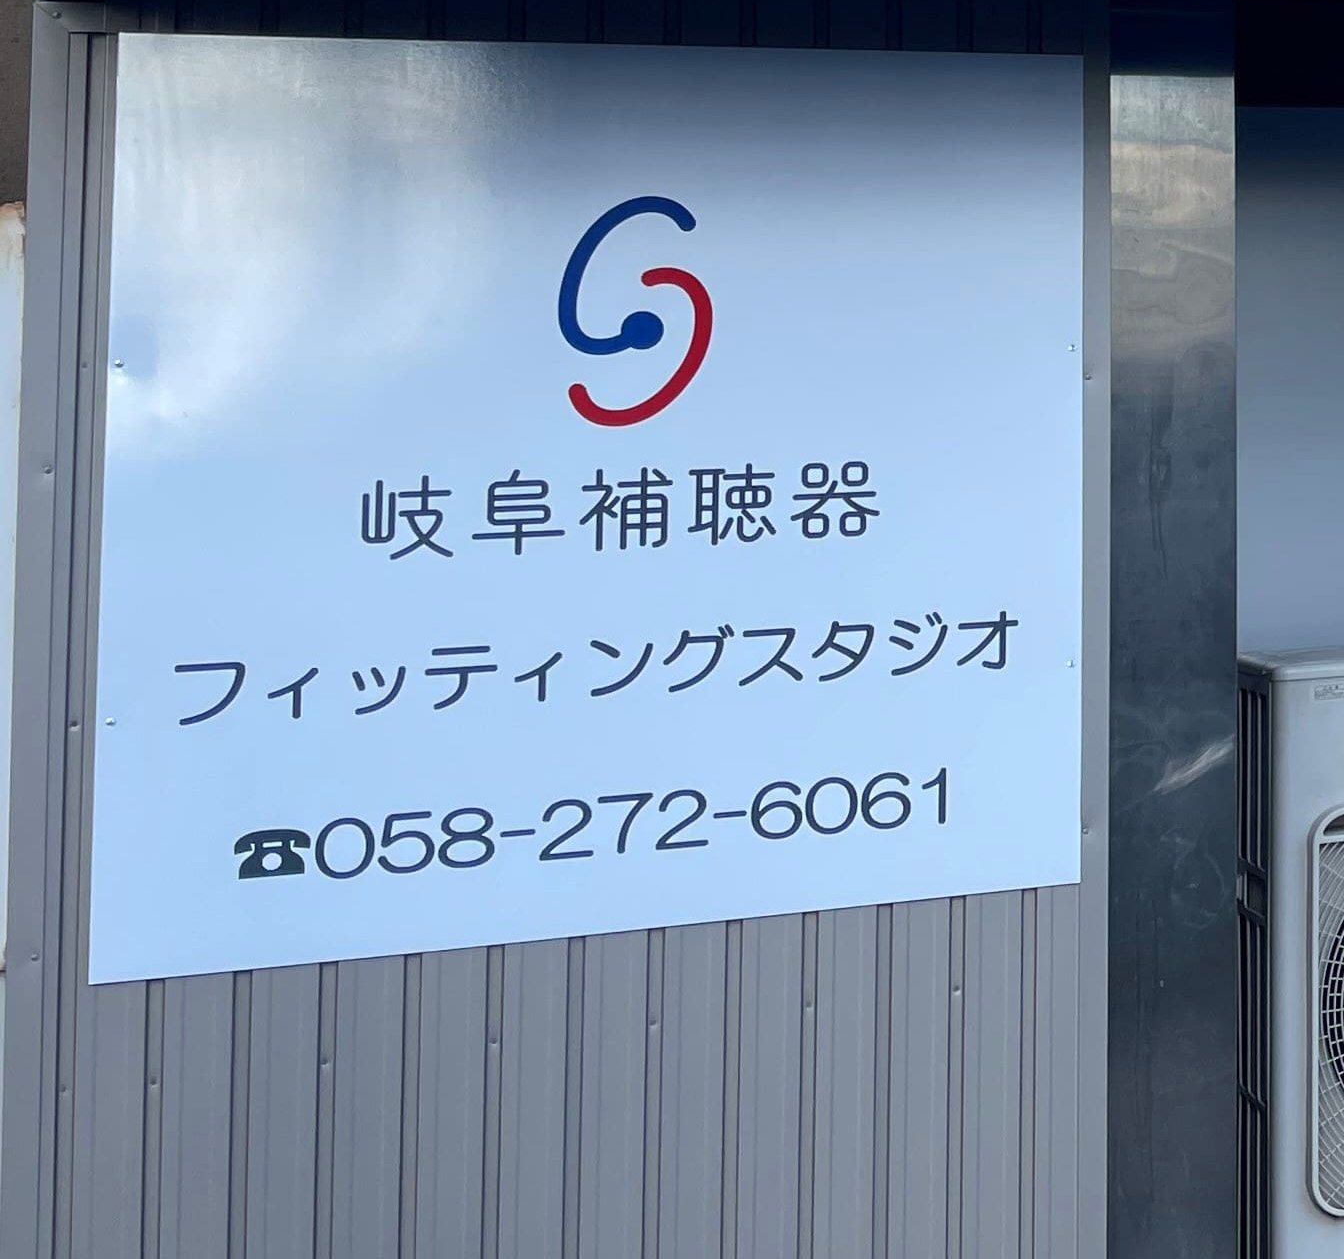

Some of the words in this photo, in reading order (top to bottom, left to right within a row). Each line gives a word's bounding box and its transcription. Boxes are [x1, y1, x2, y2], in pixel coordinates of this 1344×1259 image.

[360, 460, 881, 560] 岐阜補聴器
[173, 610, 1019, 727] フィッティングスタジオ
[315, 767, 949, 880] 058-272-6061
